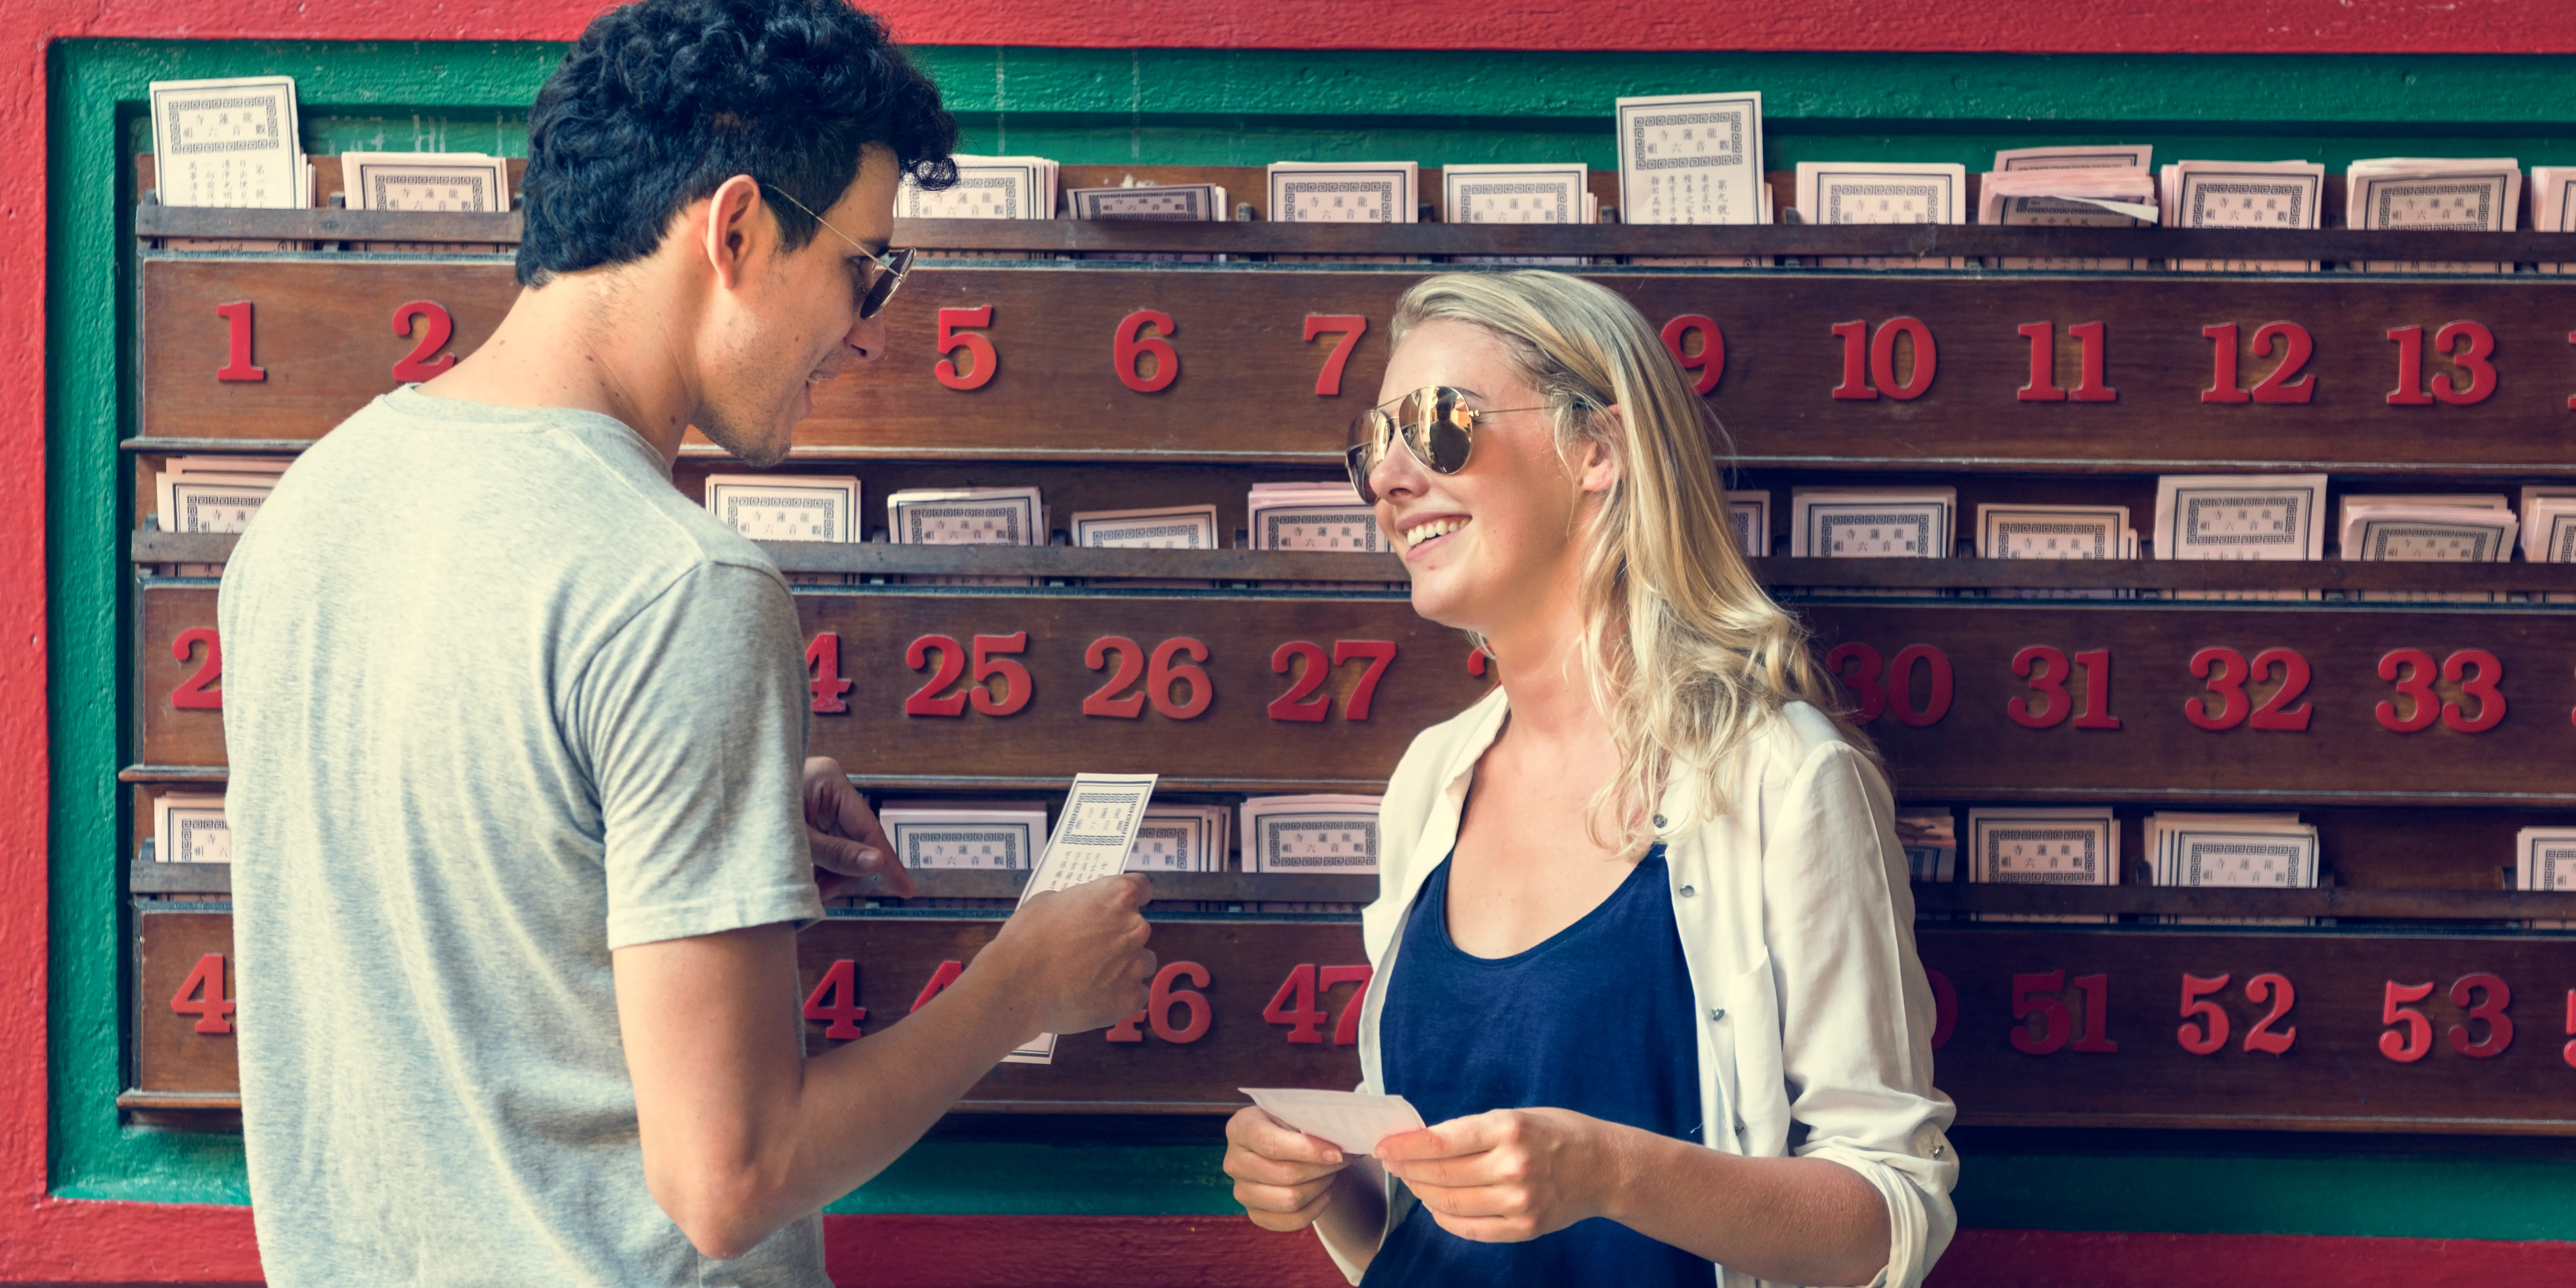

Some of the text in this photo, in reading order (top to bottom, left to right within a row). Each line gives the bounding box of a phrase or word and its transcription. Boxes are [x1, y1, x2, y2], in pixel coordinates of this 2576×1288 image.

[217, 300, 264, 381] 1
[392, 300, 455, 382] 2
[935, 305, 997, 390] 5
[1114, 310, 1178, 392] 6
[1304, 315, 1367, 395] 7
[1661, 314, 1725, 395] 9
[1832, 317, 1936, 400] 10
[2017, 321, 2117, 401] 11
[2201, 320, 2316, 403] 12
[2386, 320, 2497, 405] 13
[171, 627, 223, 709] 2
[806, 632, 852, 713] 4
[905, 632, 1032, 716] 25
[1083, 636, 1213, 719] 26
[1267, 640, 1396, 722] 27
[1826, 642, 1953, 727] 30
[2008, 645, 2120, 729] 31
[2185, 646, 2313, 731] 32
[2375, 648, 2507, 733] 33
[171, 953, 236, 1033] 4
[804, 959, 866, 1039] 4
[1263, 964, 1374, 1045] 47
[2009, 969, 2119, 1055] 51
[2177, 973, 2296, 1055] 52
[2379, 972, 2514, 1062] 53
